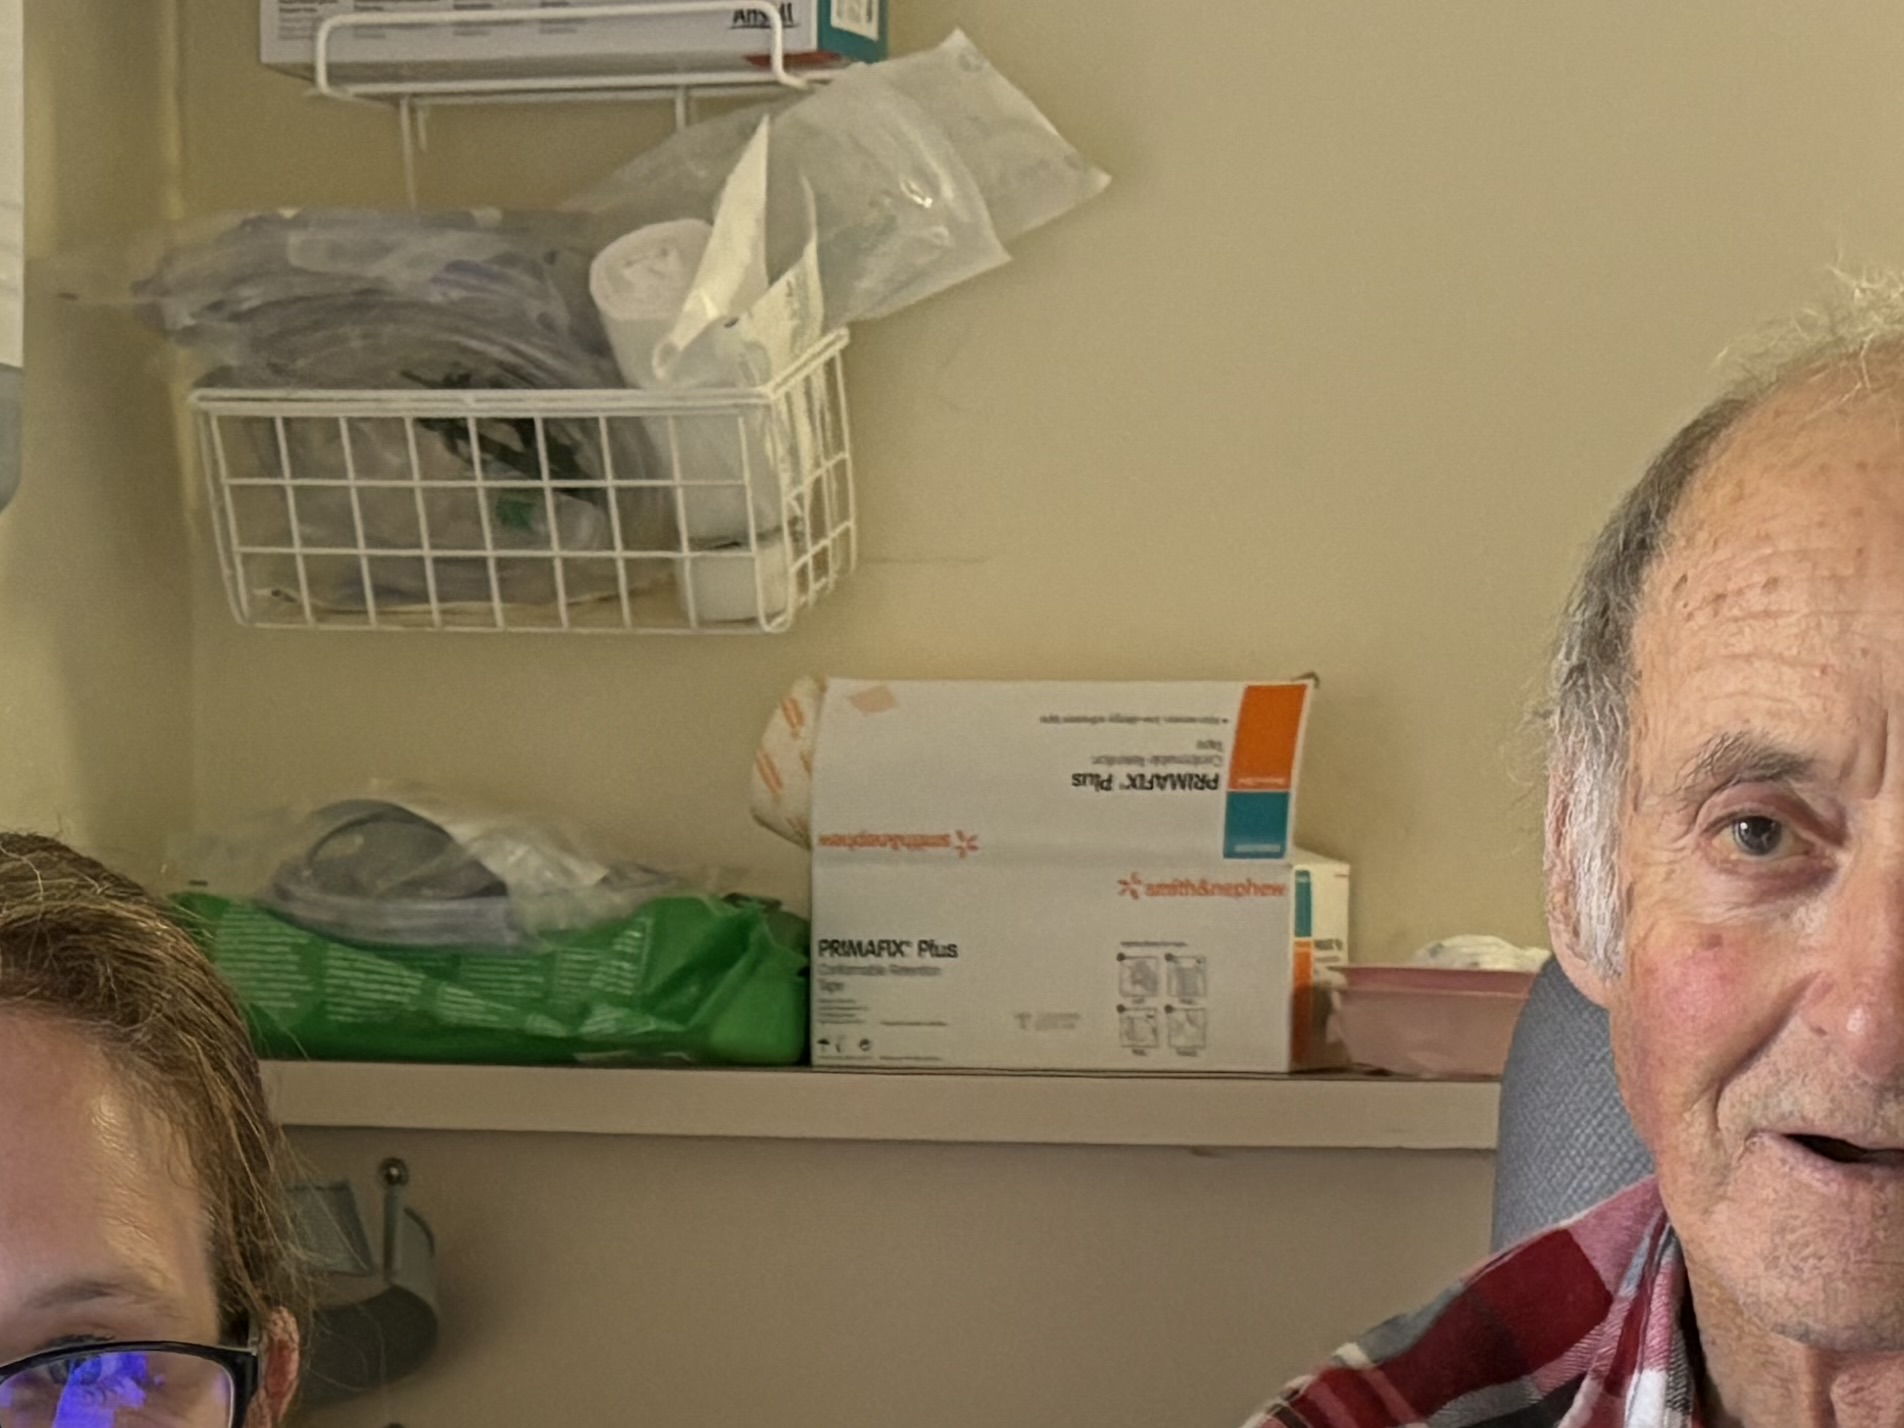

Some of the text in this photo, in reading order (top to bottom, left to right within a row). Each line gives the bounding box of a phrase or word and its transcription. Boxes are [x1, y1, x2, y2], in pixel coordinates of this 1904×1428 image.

[733, 2, 794, 26] Ansll
[1071, 772, 1114, 792] Plus
[1144, 878, 1287, 899] smith&nephew
[916, 938, 959, 959] Plus
